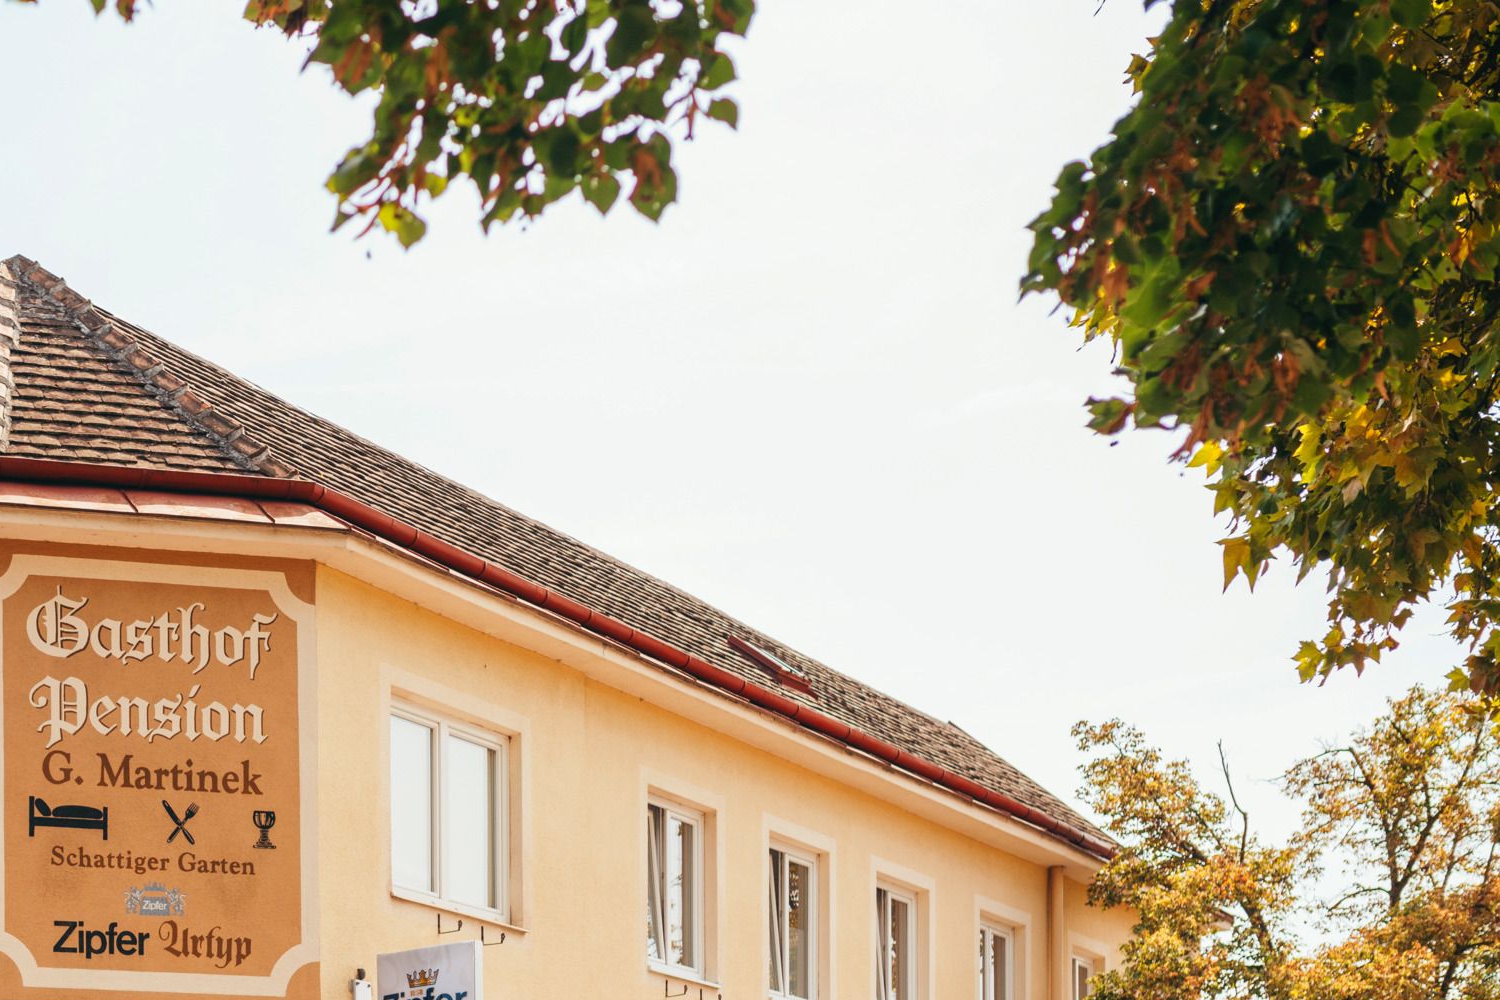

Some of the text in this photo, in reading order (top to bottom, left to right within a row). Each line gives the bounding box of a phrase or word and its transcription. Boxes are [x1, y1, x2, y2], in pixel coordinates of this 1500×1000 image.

[26, 585, 278, 680] Gasthof
[29, 676, 268, 750] Pension
[42, 750, 263, 796] G. Martinek
[50, 846, 256, 876] Schattiger Garten
[142, 900, 167, 911] Zipfer
[53, 920, 150, 959] Zipfer
